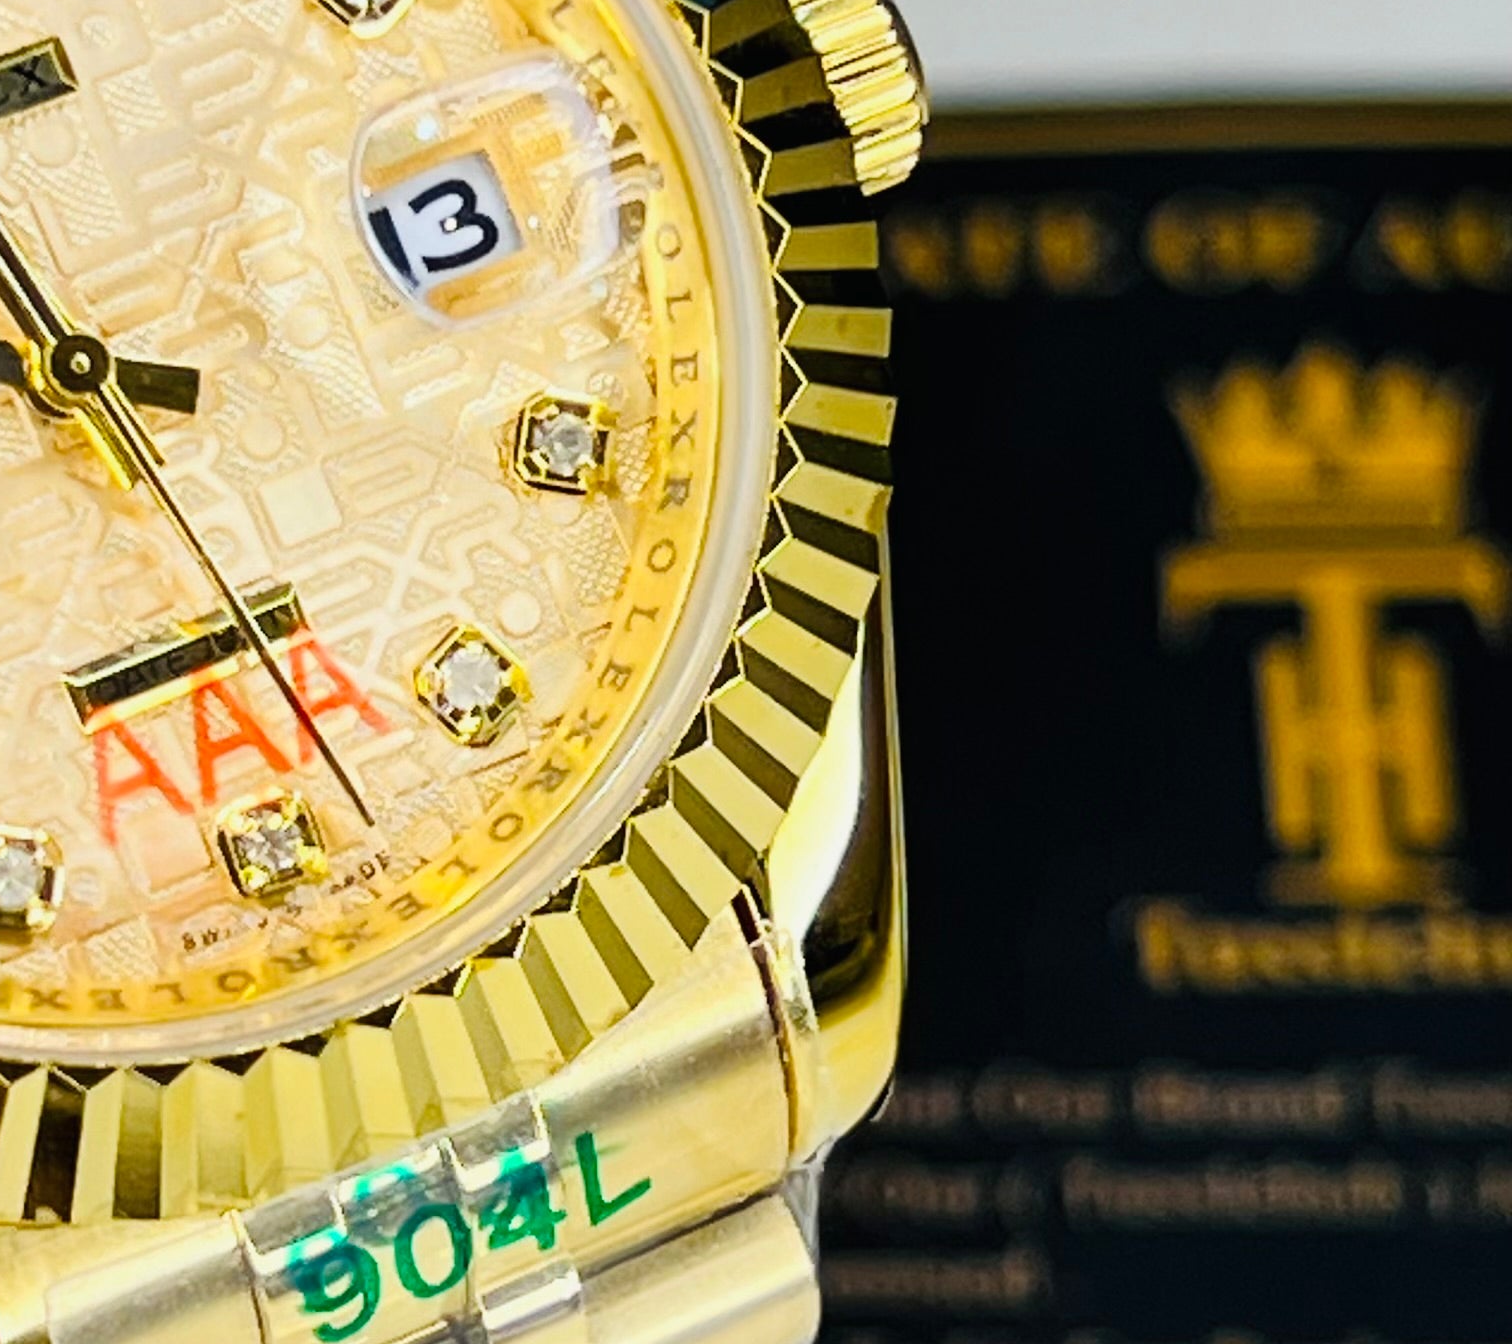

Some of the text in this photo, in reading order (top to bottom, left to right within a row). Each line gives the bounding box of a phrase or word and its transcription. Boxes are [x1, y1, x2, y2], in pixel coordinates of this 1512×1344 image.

[368, 178, 500, 290] 13
[564, 468, 695, 751] ROLEX
[92, 626, 396, 848] AAA
[293, 1131, 652, 1344] 904L
